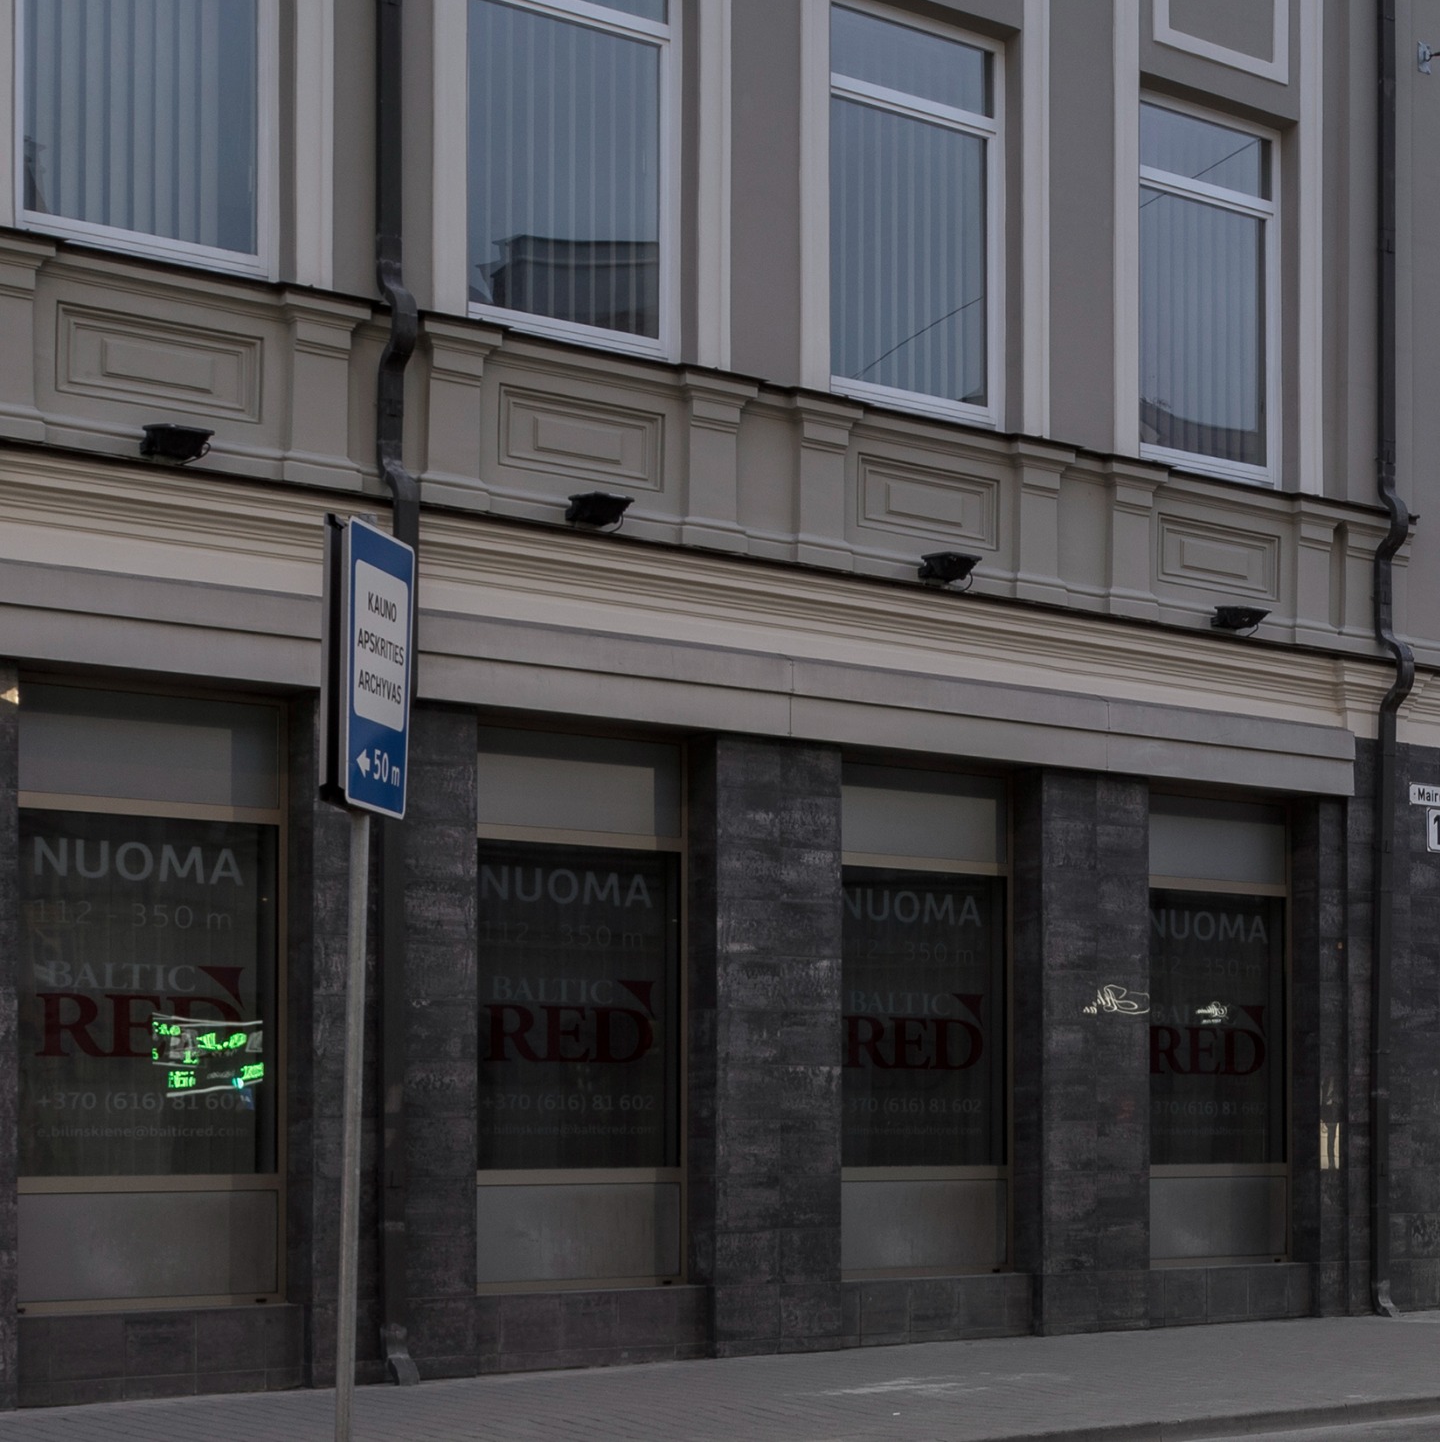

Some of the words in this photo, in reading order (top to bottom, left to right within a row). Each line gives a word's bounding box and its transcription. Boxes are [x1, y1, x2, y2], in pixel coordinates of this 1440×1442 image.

[368, 591, 397, 623] KAUNO
[357, 628, 404, 667] APSKRITIES
[358, 669, 402, 706] ARCHYVAS
[373, 749, 389, 782] 50
[391, 764, 400, 787] m
[34, 836, 244, 887] NUOMA
[480, 865, 653, 908] NUOMA
[34, 899, 92, 925] 112
[132, 903, 193, 929] 350
[842, 887, 983, 928] NUOMA
[482, 920, 528, 944] 112
[560, 923, 610, 948] 350
[1150, 908, 1268, 944] NUOMA
[904, 940, 947, 964] 350
[1203, 957, 1240, 977] 350
[46, 960, 197, 993] BALTIC
[491, 974, 614, 1005] BALTIC
[850, 989, 950, 1016] BALTIC
[35, 992, 245, 1059] RED
[483, 1003, 655, 1064] RED
[842, 1015, 984, 1071] RED
[1150, 1024, 1266, 1076] RED
[37, 1092, 97, 1110] +370
[104, 1092, 165, 1114] (616)
[171, 1096, 198, 1110] 81
[483, 1094, 530, 1110] +370
[538, 1093, 586, 1114] (616)
[592, 1095, 613, 1111] 81
[619, 1095, 655, 1111] 602
[883, 1097, 925, 1115] (616)
[928, 1098, 947, 1114] 81
[952, 1098, 982, 1114] 602
[1184, 1100, 1218, 1119] (616)
[1222, 1101, 1237, 1116] 81
[37, 1124, 248, 1139] e.bilinskiene@balticred.com
